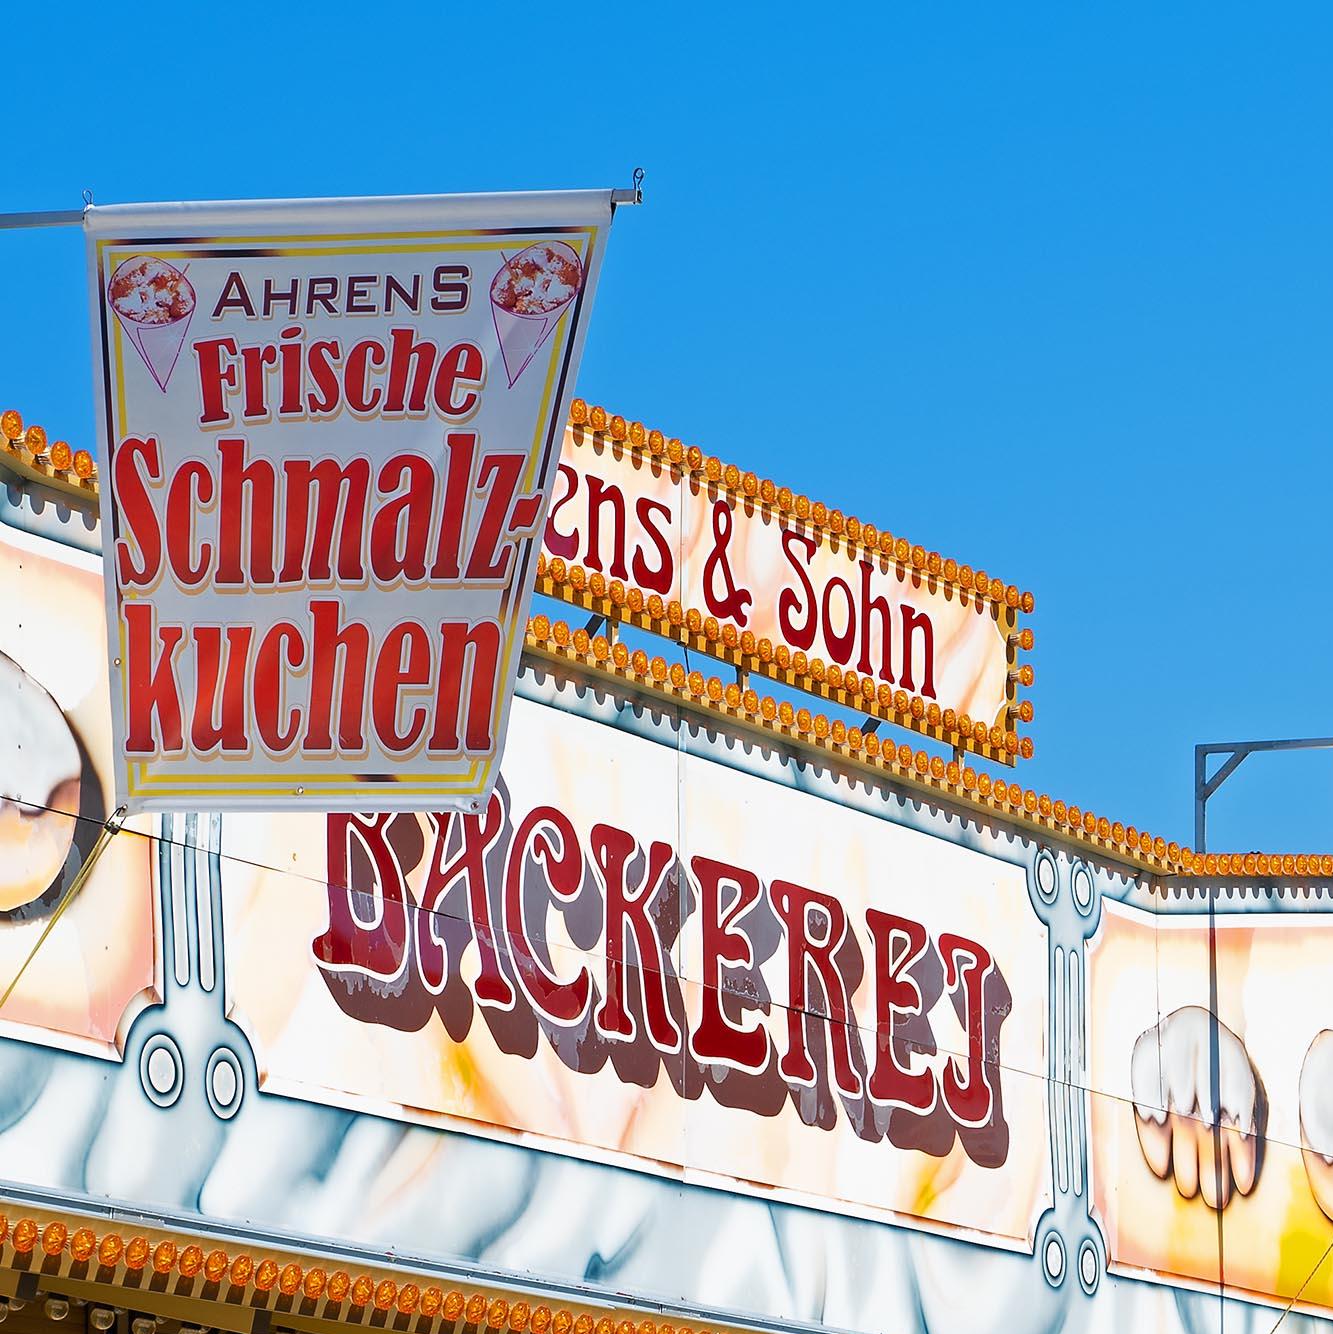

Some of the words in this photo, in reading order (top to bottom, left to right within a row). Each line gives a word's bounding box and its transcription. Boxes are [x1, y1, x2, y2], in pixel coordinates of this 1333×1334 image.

[213, 265, 471, 317] AHRENS
[194, 326, 484, 426] Frische
[114, 432, 543, 586] Schmalz-
[124, 600, 502, 753] kuchen
[703, 499, 753, 628] &
[778, 528, 937, 701] Sohn
